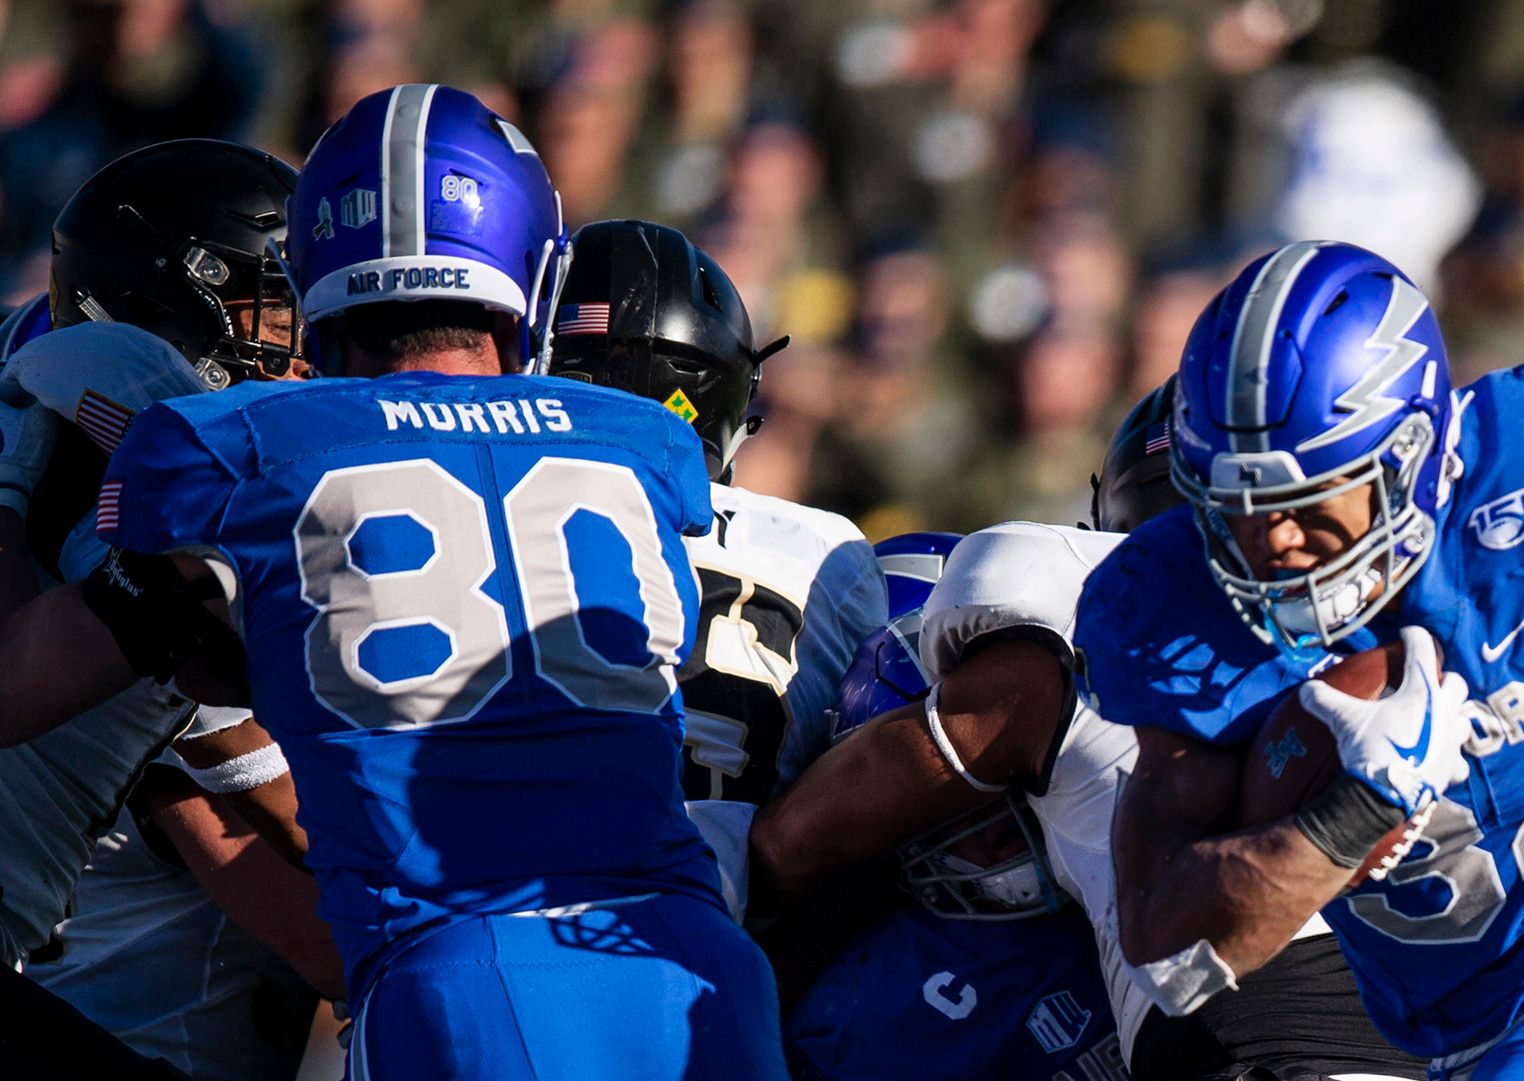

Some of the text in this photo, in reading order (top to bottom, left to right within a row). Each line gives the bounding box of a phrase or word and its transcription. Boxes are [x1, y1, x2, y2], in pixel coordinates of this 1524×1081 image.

[441, 175, 479, 203] 80
[347, 267, 469, 295] AIR FORCE
[377, 398, 573, 434] MORRIS
[293, 456, 685, 730] 80
[923, 971, 978, 1020] C
